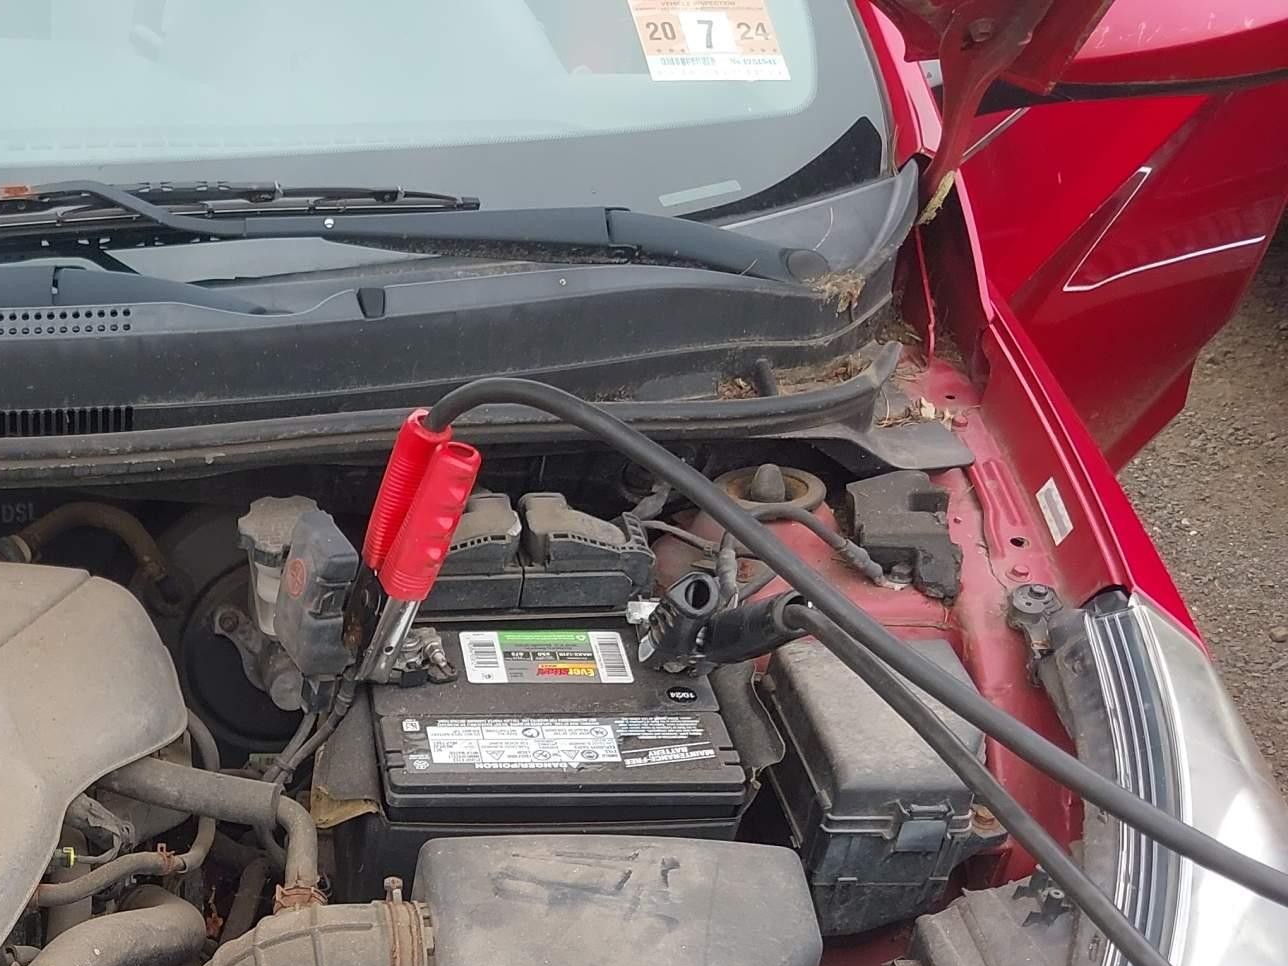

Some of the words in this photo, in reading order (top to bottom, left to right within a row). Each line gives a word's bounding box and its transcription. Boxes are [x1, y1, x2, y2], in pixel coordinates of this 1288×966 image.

[645, 21, 677, 41] 20
[696, 20, 714, 49] 7
[736, 22, 770, 41] 24
[669, 691, 696, 699] 10/24
[623, 750, 716, 766] MAINTENANCE-FREE
[648, 747, 688, 758] BATTERY
